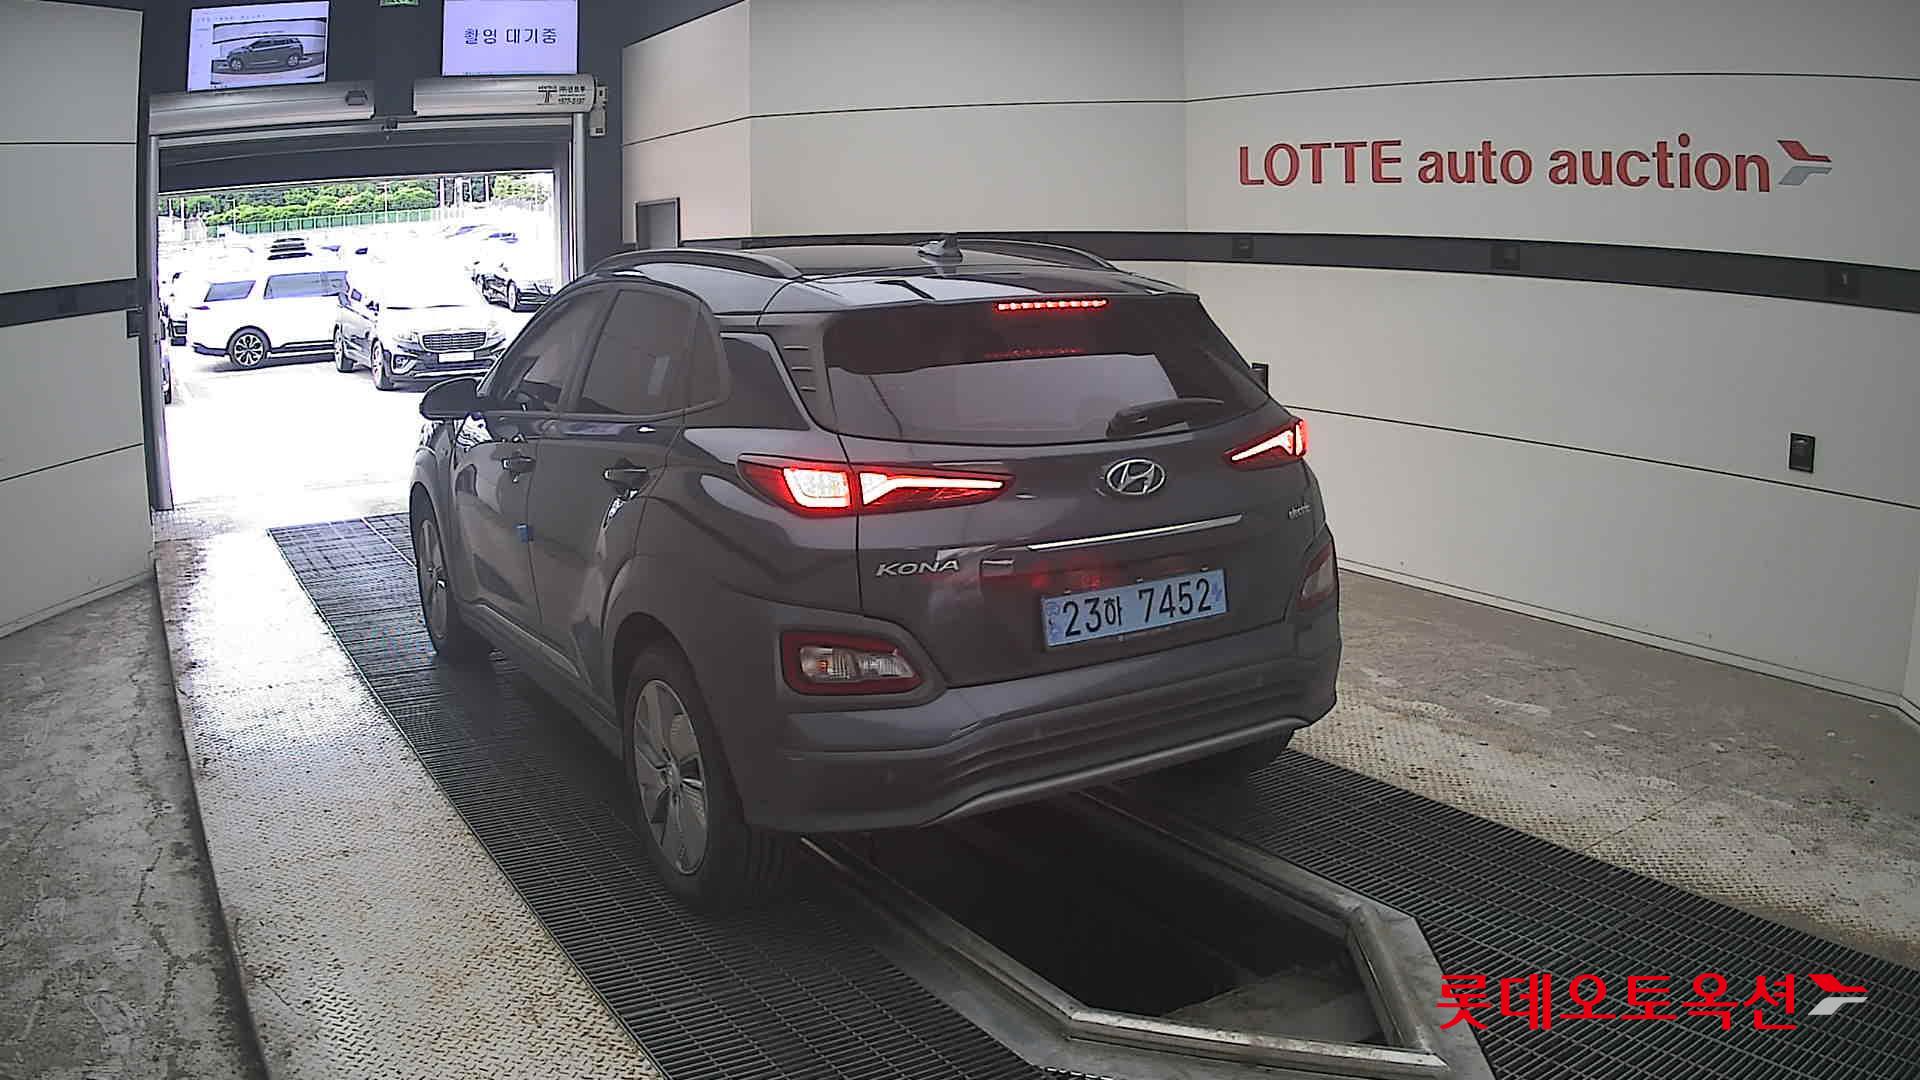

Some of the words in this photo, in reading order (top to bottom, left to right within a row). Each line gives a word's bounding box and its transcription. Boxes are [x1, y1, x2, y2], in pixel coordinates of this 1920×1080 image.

[506, 28, 558, 45] 대기중
[1239, 139, 1402, 186] LOTTE
[1417, 140, 1532, 185] auto
[1549, 133, 1770, 193] auction
[876, 560, 960, 577] KONA
[1062, 595, 1123, 638] 23하
[1138, 577, 1212, 624] 7452
